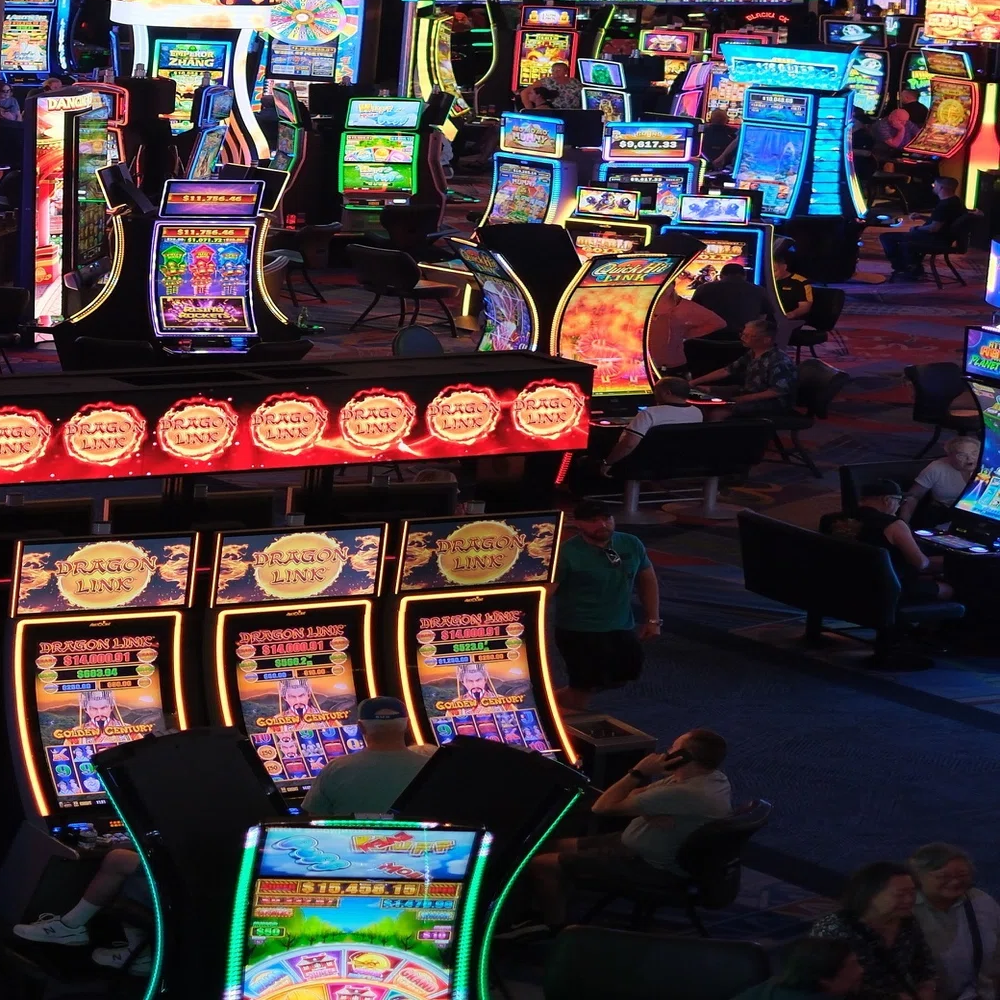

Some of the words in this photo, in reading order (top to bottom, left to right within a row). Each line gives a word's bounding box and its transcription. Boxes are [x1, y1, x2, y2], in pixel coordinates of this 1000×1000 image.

[169, 49, 214, 58] EMPEROR
[168, 58, 214, 68] ZHANG
[618, 140, 677, 150] $9,617.33
[592, 261, 640, 277] Quick
[603, 273, 647, 283] LINK
[340, 403, 417, 421] DRAGON
[427, 400, 502, 418] DRAGON
[512, 394, 586, 413] DRAGON
[158, 414, 239, 433] DRAGON
[250, 409, 330, 427] DRAGON
[441, 416, 486, 431] LINK
[526, 411, 569, 426] LINK
[63, 419, 146, 438] DRAGON
[265, 426, 310, 441] LINK
[354, 420, 399, 435] LINK
[80, 436, 128, 451] LINK
[174, 431, 219, 446] LINK
[435, 533, 527, 554] DRAGON
[251, 546, 350, 567] DRAGON
[450, 554, 508, 572] LINK
[54, 555, 158, 578] DRAGON
[270, 566, 330, 585] LINK
[74, 576, 136, 595] LINK
[418, 613, 484, 629] DRAGON
[484, 610, 522, 624] LINK
[238, 627, 304, 644] DRAGON
[305, 624, 346, 639] LINK
[38, 637, 111, 654] DRAGON
[112, 635, 156, 650] LINK
[434, 699, 478, 711] GOLDEN
[480, 694, 526, 708] CENTURY
[255, 714, 300, 727] GOLDEN
[303, 709, 351, 723] CENTURY
[52, 727, 101, 740] GOLDEN
[104, 723, 155, 738] CENTURY
[301, 881, 417, 895] $15,458.15
